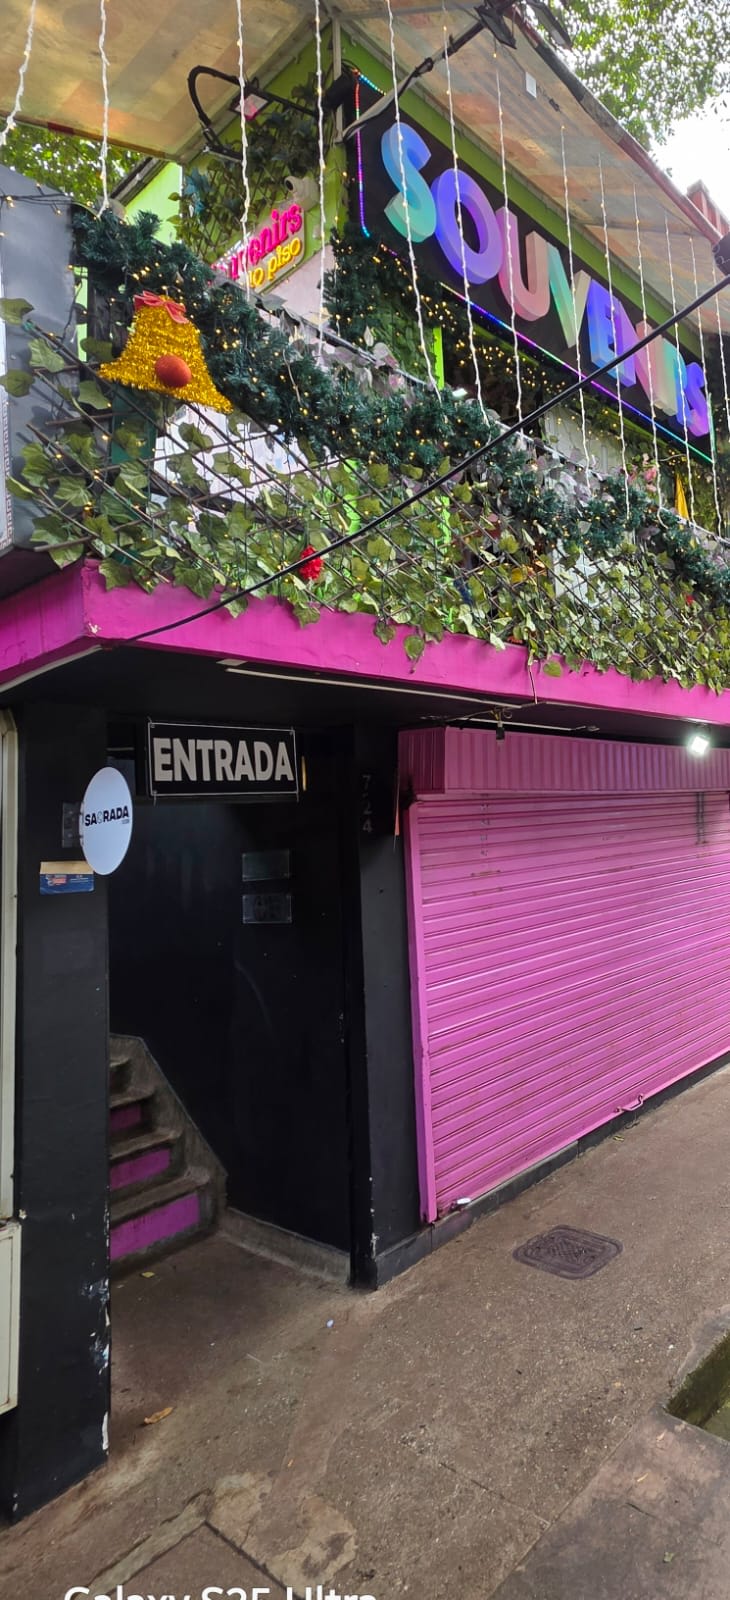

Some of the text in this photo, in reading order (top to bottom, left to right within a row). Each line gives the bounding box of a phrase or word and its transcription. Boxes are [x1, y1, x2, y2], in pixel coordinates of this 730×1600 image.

[267, 237, 301, 281] piso
[381, 122, 710, 437] SOUVENIRS
[153, 737, 295, 782] ENTRADA
